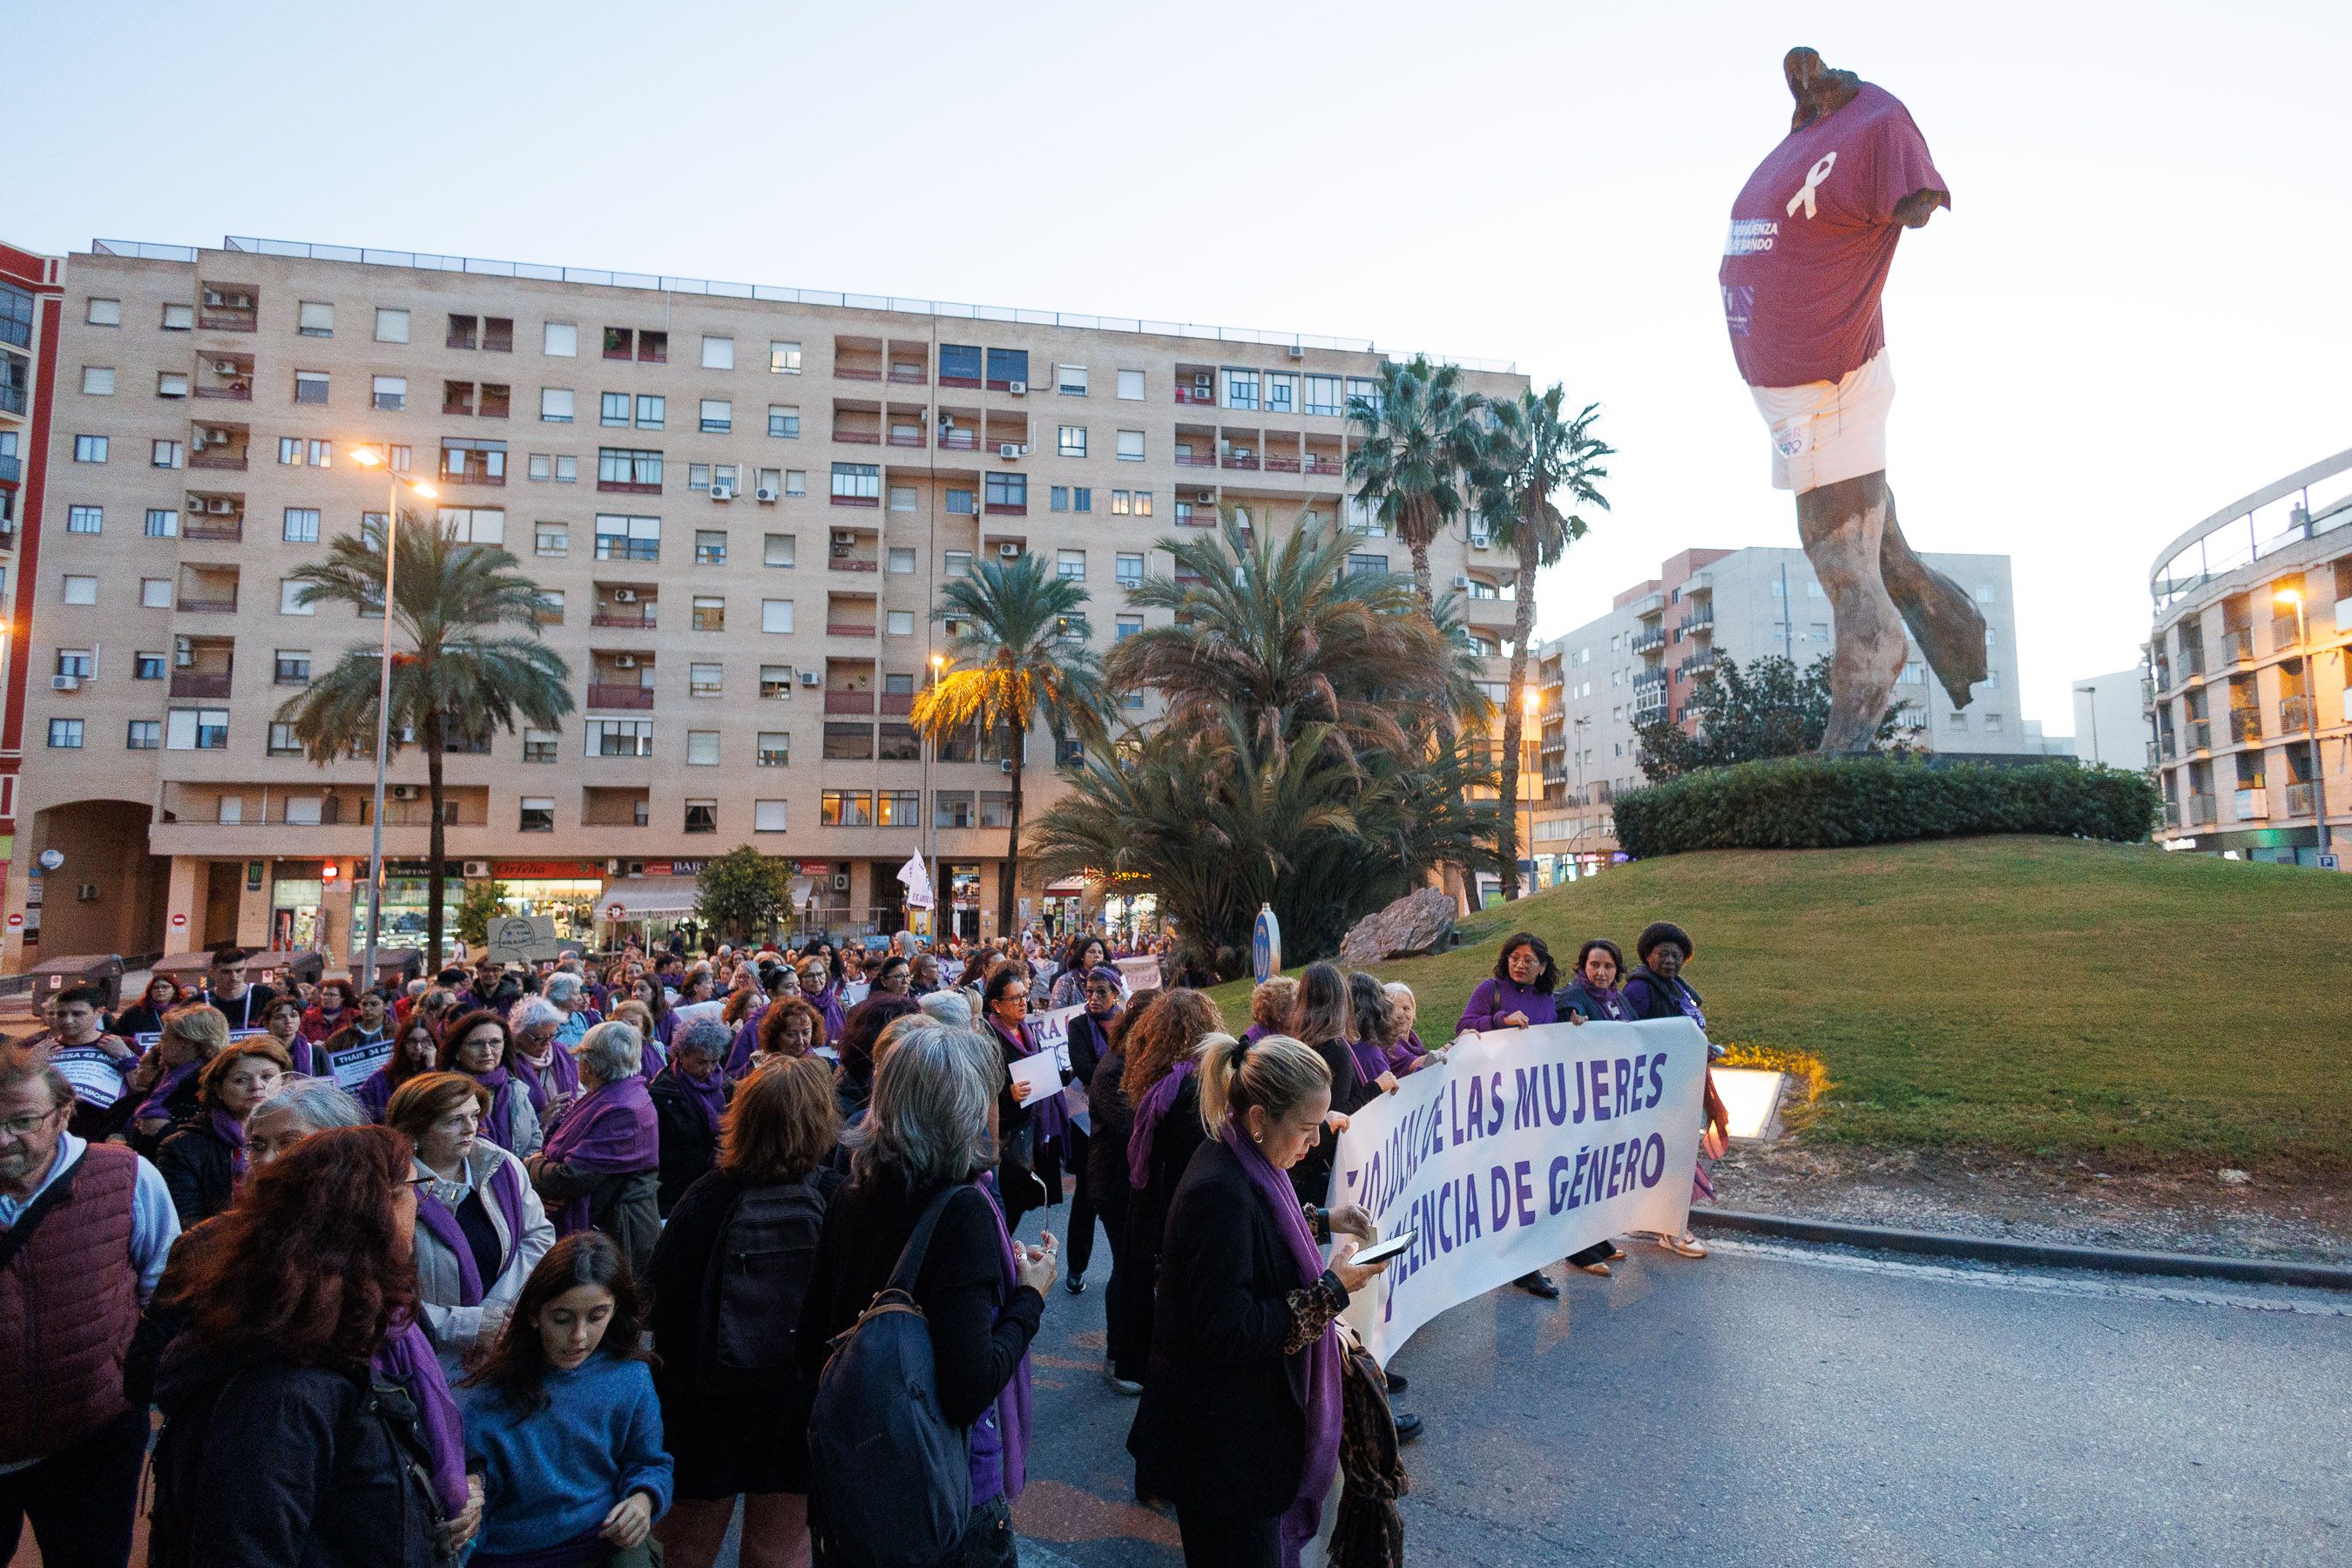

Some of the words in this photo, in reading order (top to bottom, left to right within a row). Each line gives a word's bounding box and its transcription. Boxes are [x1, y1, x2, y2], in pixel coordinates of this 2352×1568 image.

[673, 862, 700, 871] BAR
[338, 1051, 365, 1064] THAIS
[1378, 1104, 1425, 1221] LOCAL
[1421, 1085, 1446, 1164] DE
[1451, 1071, 1505, 1147] LAS
[1514, 1052, 1667, 1131] MUJERES
[1490, 1160, 1536, 1233] DE
[1549, 1132, 1666, 1216] GÉNERO
